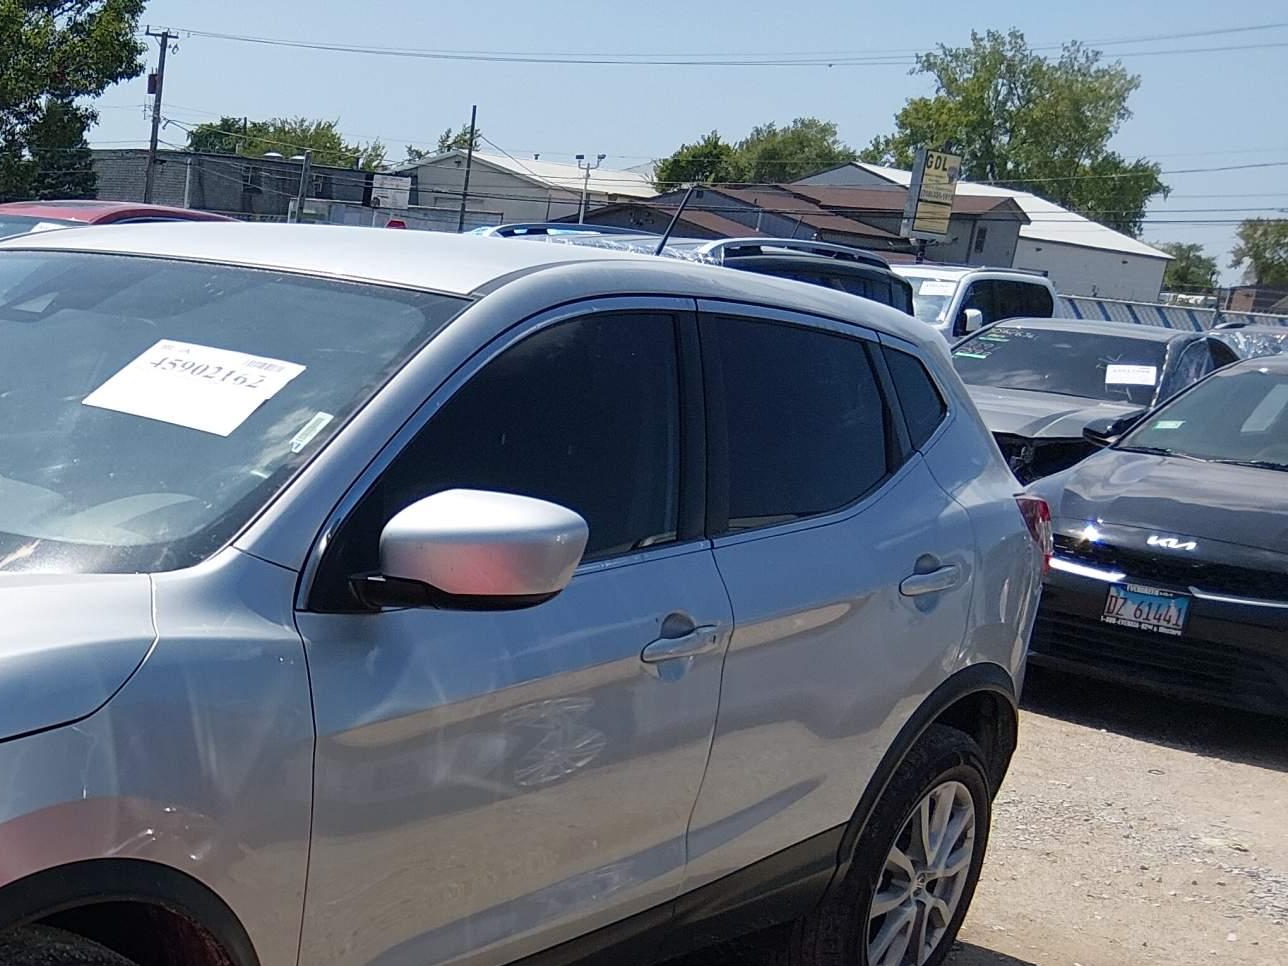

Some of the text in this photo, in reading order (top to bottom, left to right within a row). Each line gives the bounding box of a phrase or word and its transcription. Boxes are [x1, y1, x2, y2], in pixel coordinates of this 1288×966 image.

[926, 154, 948, 172] GDL
[149, 356, 267, 388] 45902162
[1147, 535, 1198, 550] KIA
[1106, 594, 1128, 616] DZ
[1133, 600, 1183, 627] 61441
